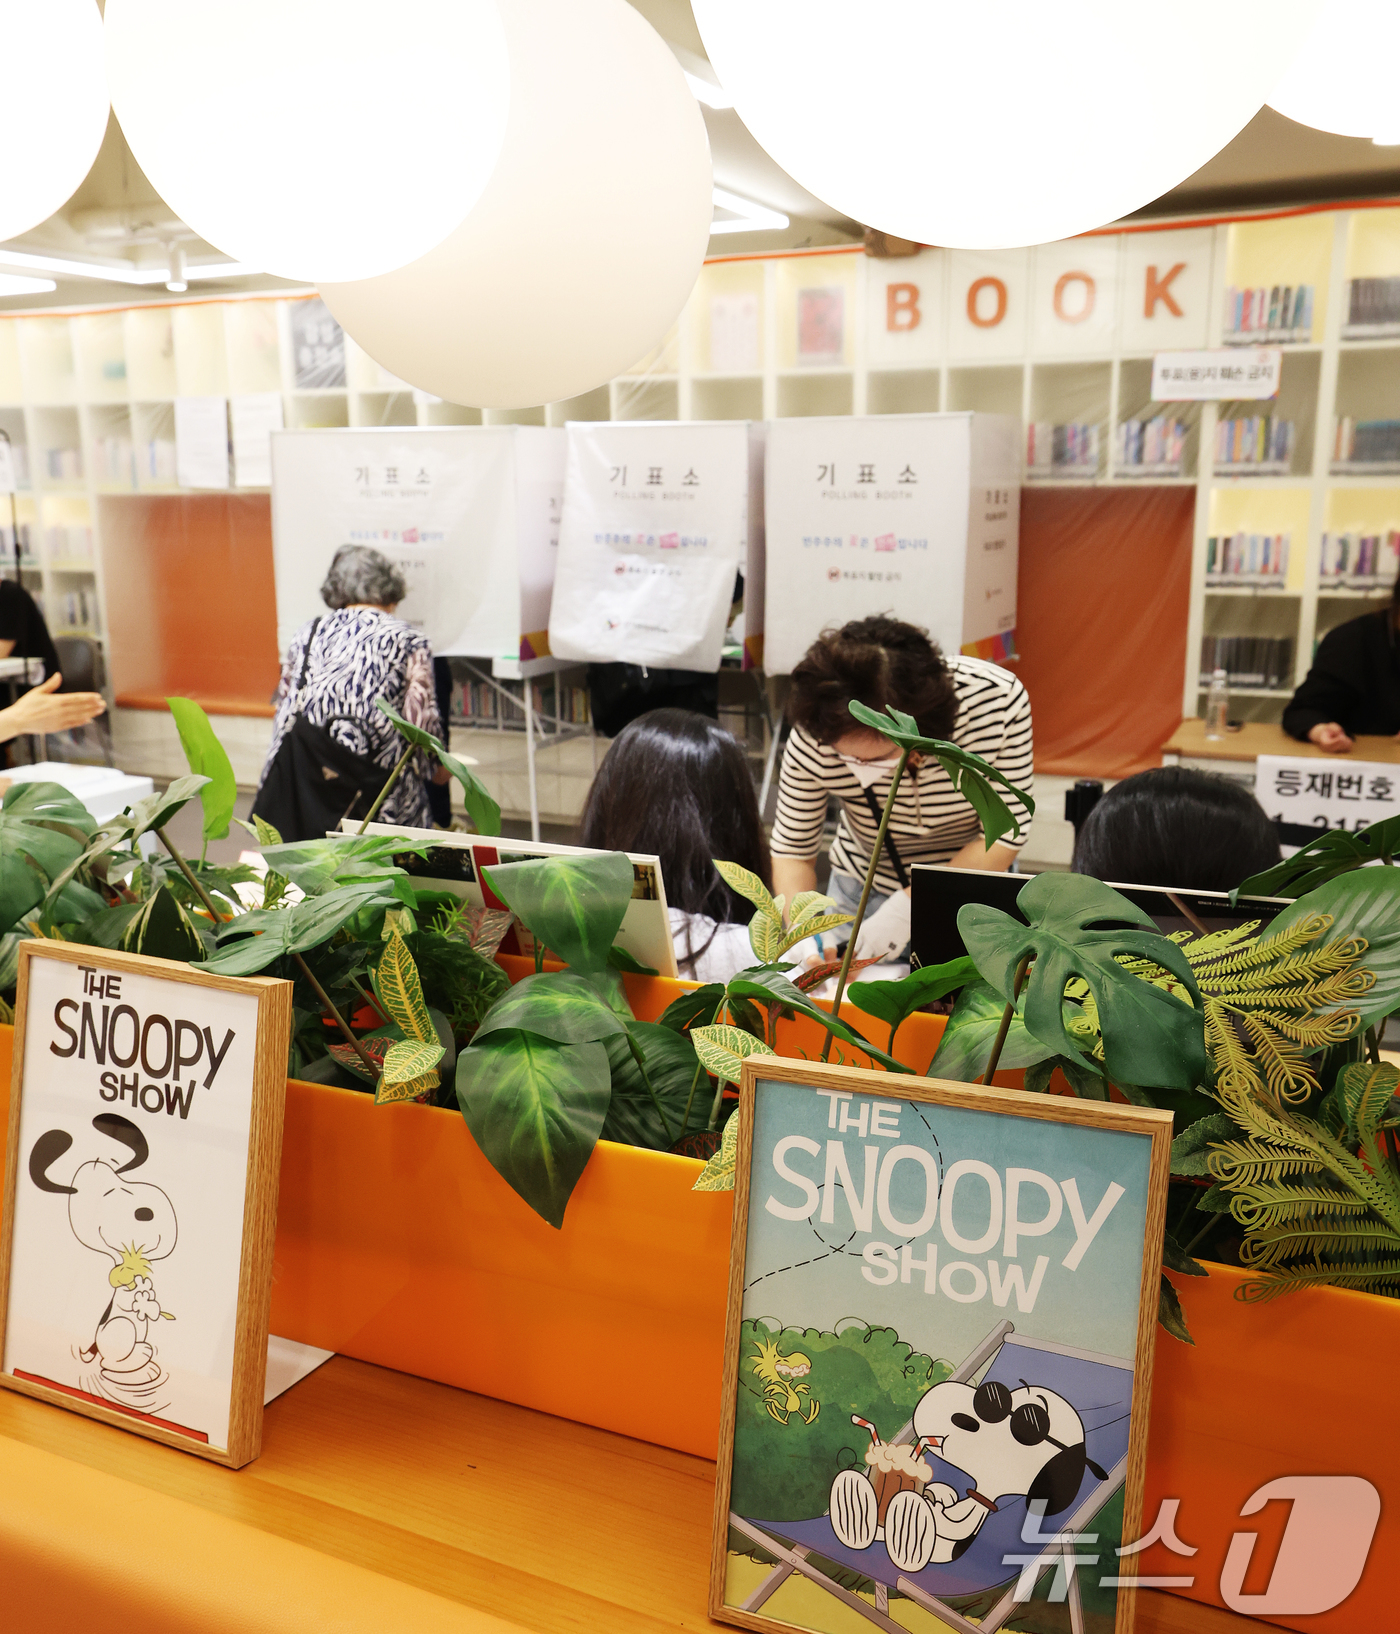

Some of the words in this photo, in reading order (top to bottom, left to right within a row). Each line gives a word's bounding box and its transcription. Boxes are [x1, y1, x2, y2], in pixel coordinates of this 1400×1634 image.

[886, 262, 1188, 333] BOOK
[1274, 769, 1395, 802] 등재번호
[77, 965, 122, 1000] THE
[49, 997, 236, 1090] SNOOPY
[99, 1072, 197, 1120] SHOW
[816, 1088, 902, 1138] THE
[764, 1135, 1126, 1272] SNOOPY
[860, 1241, 1050, 1314] SHOW
